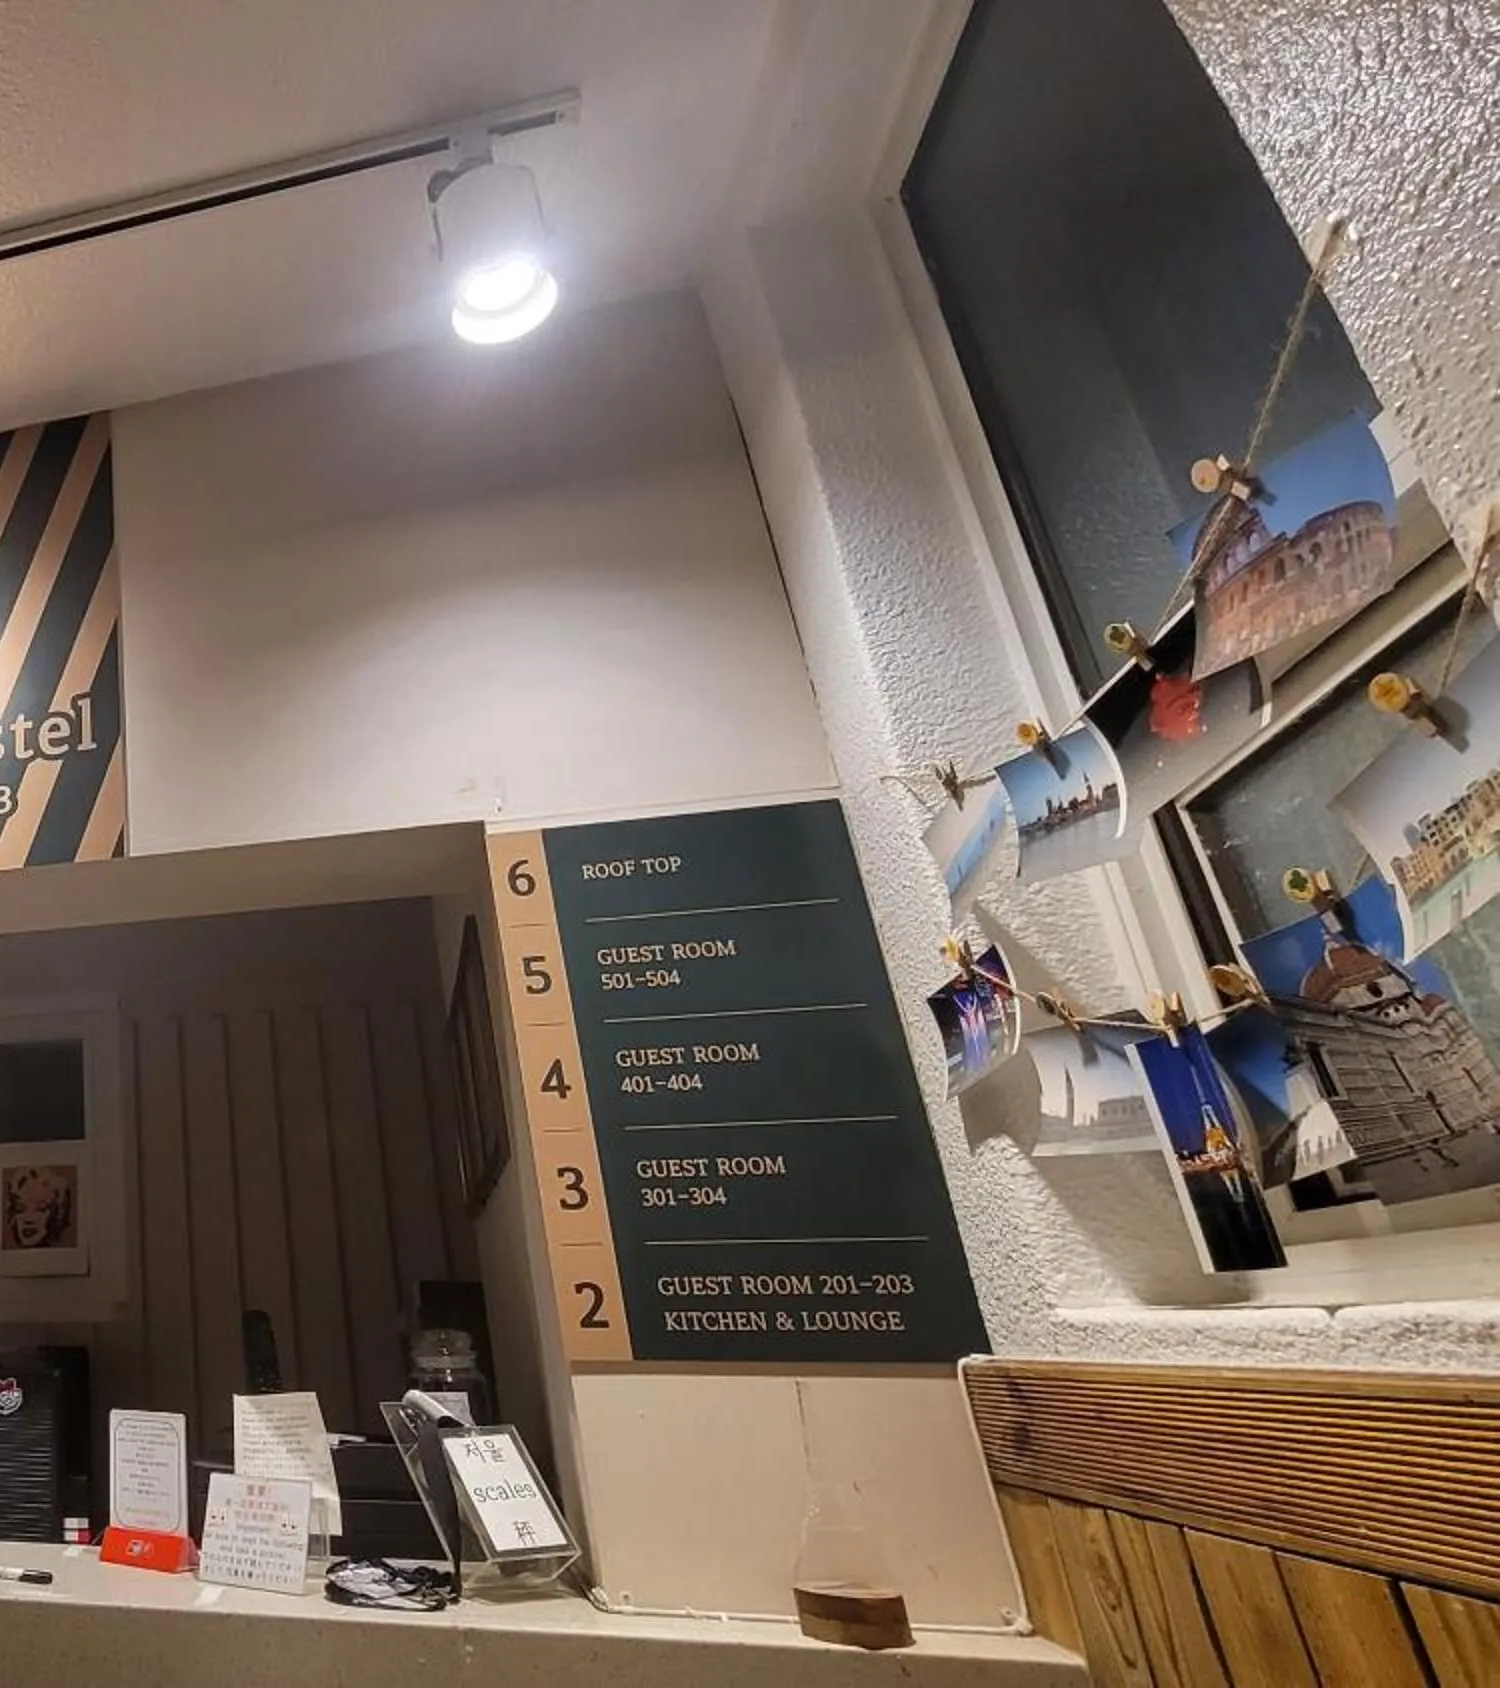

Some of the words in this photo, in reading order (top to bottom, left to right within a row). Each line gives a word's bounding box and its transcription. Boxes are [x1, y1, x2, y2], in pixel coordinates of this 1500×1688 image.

[506, 858, 536, 897] 6
[581, 858, 636, 881] ROOF
[641, 855, 682, 876] TOP
[597, 943, 664, 966] GUEST
[672, 939, 737, 961] ROOM
[522, 955, 553, 995] 5
[601, 968, 682, 990] 501-504
[615, 1047, 686, 1068] GUEST
[693, 1043, 760, 1065] ROOM
[540, 1058, 572, 1100] 4
[620, 1073, 703, 1094] 401-404
[636, 1158, 709, 1180] GUEST
[716, 1155, 786, 1177] ROOM
[556, 1166, 589, 1211] 3
[642, 1186, 728, 1208] 301-304
[657, 1276, 733, 1297] GUEST
[741, 1275, 813, 1297] ROOM
[820, 1274, 915, 1296] 201-203
[574, 1281, 610, 1329] 2
[664, 1311, 768, 1333] KITCHEN
[776, 1312, 796, 1332] &
[801, 1311, 906, 1332] LOUNGE
[473, 1478, 537, 1503] scales
